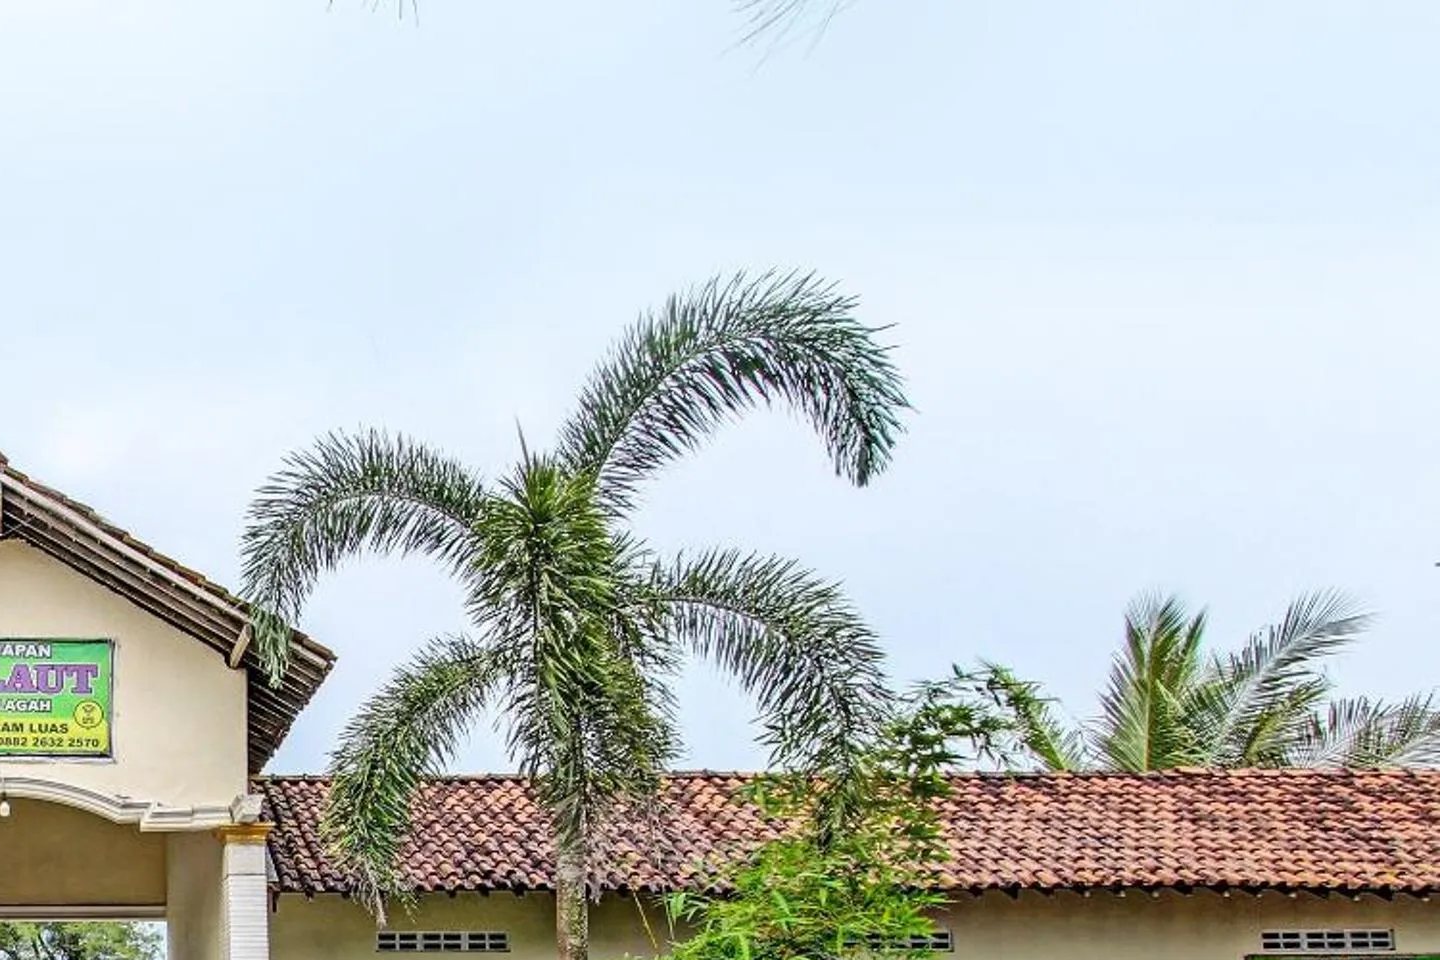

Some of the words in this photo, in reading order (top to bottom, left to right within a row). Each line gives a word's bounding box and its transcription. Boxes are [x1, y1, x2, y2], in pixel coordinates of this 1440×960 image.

[30, 723, 69, 734] LUAS
[32, 737, 64, 748] 2632
[68, 738, 100, 748] 2570
